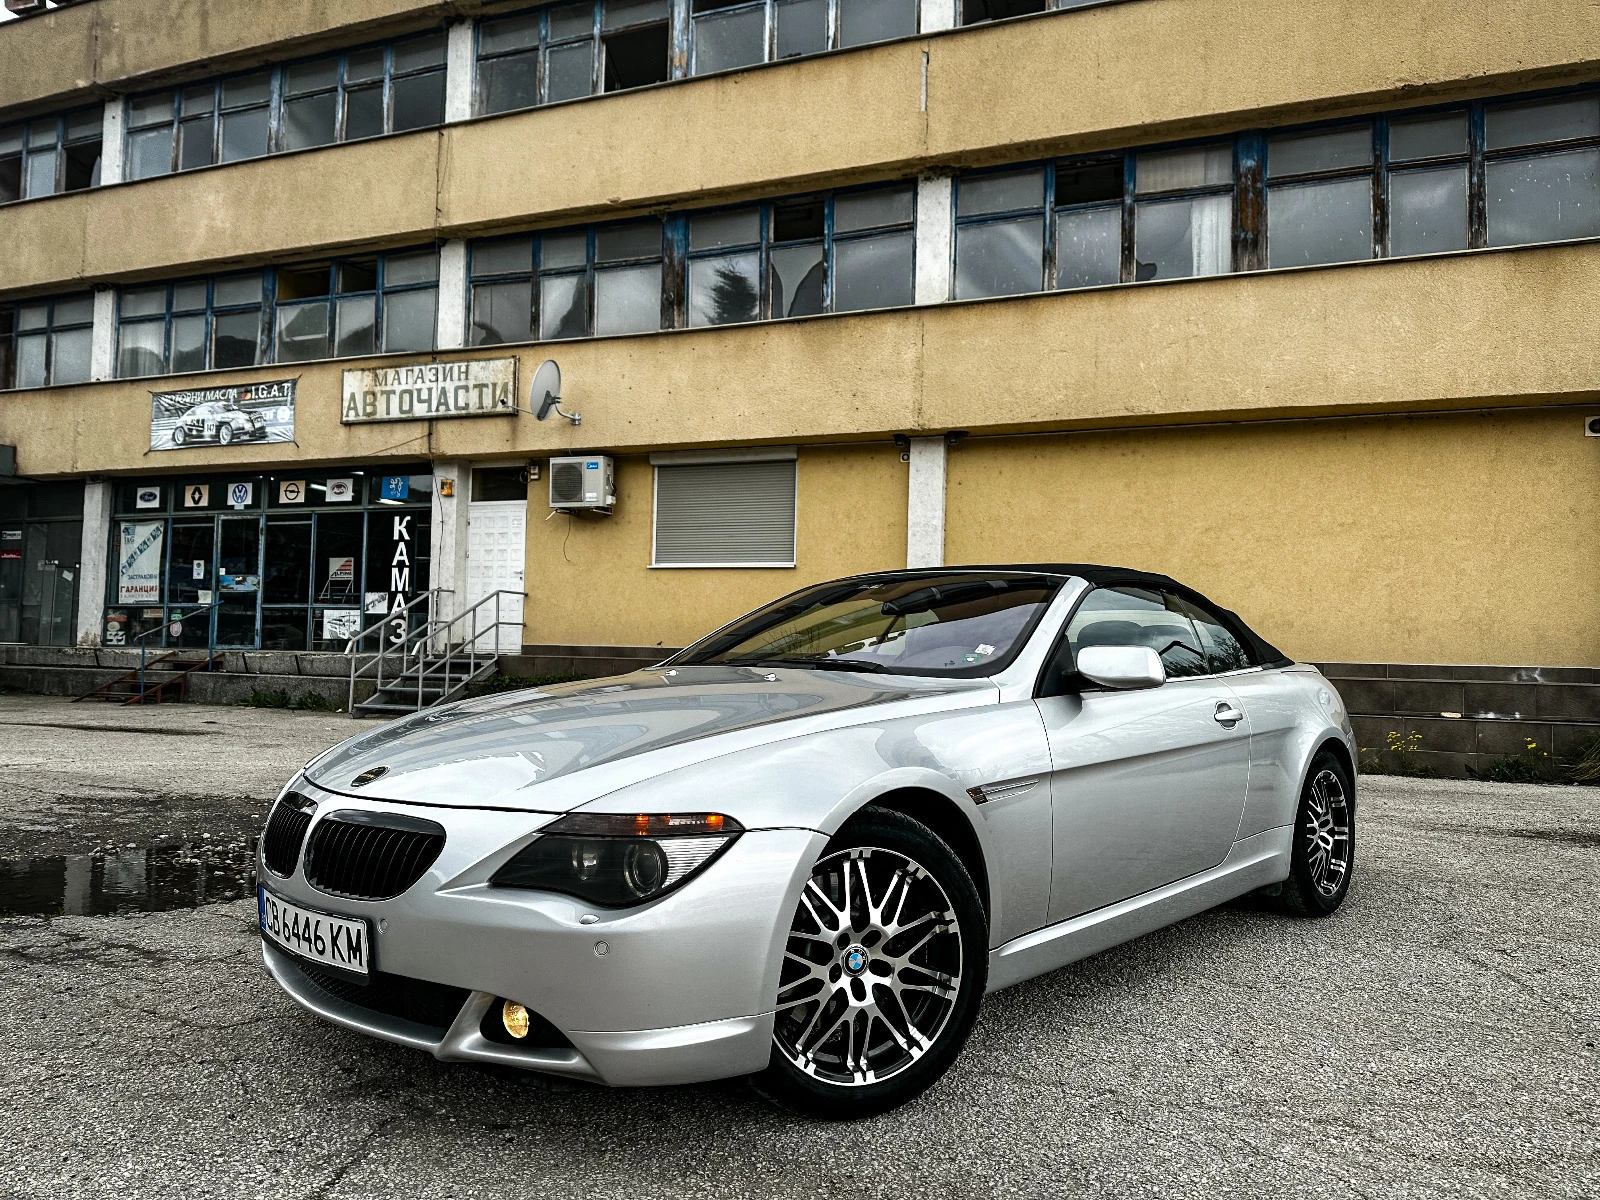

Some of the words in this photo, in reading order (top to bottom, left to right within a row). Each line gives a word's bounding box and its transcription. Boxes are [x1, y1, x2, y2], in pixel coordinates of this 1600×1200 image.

[374, 364, 470, 387] МАГАЗИН
[205, 388, 238, 401] МАСЛА
[344, 381, 510, 418] АВТОЧАСТИ
[389, 515, 411, 643] КАМАЗ
[266, 896, 280, 937] CB
[283, 907, 326, 956] 6446
[329, 922, 363, 967] KM
